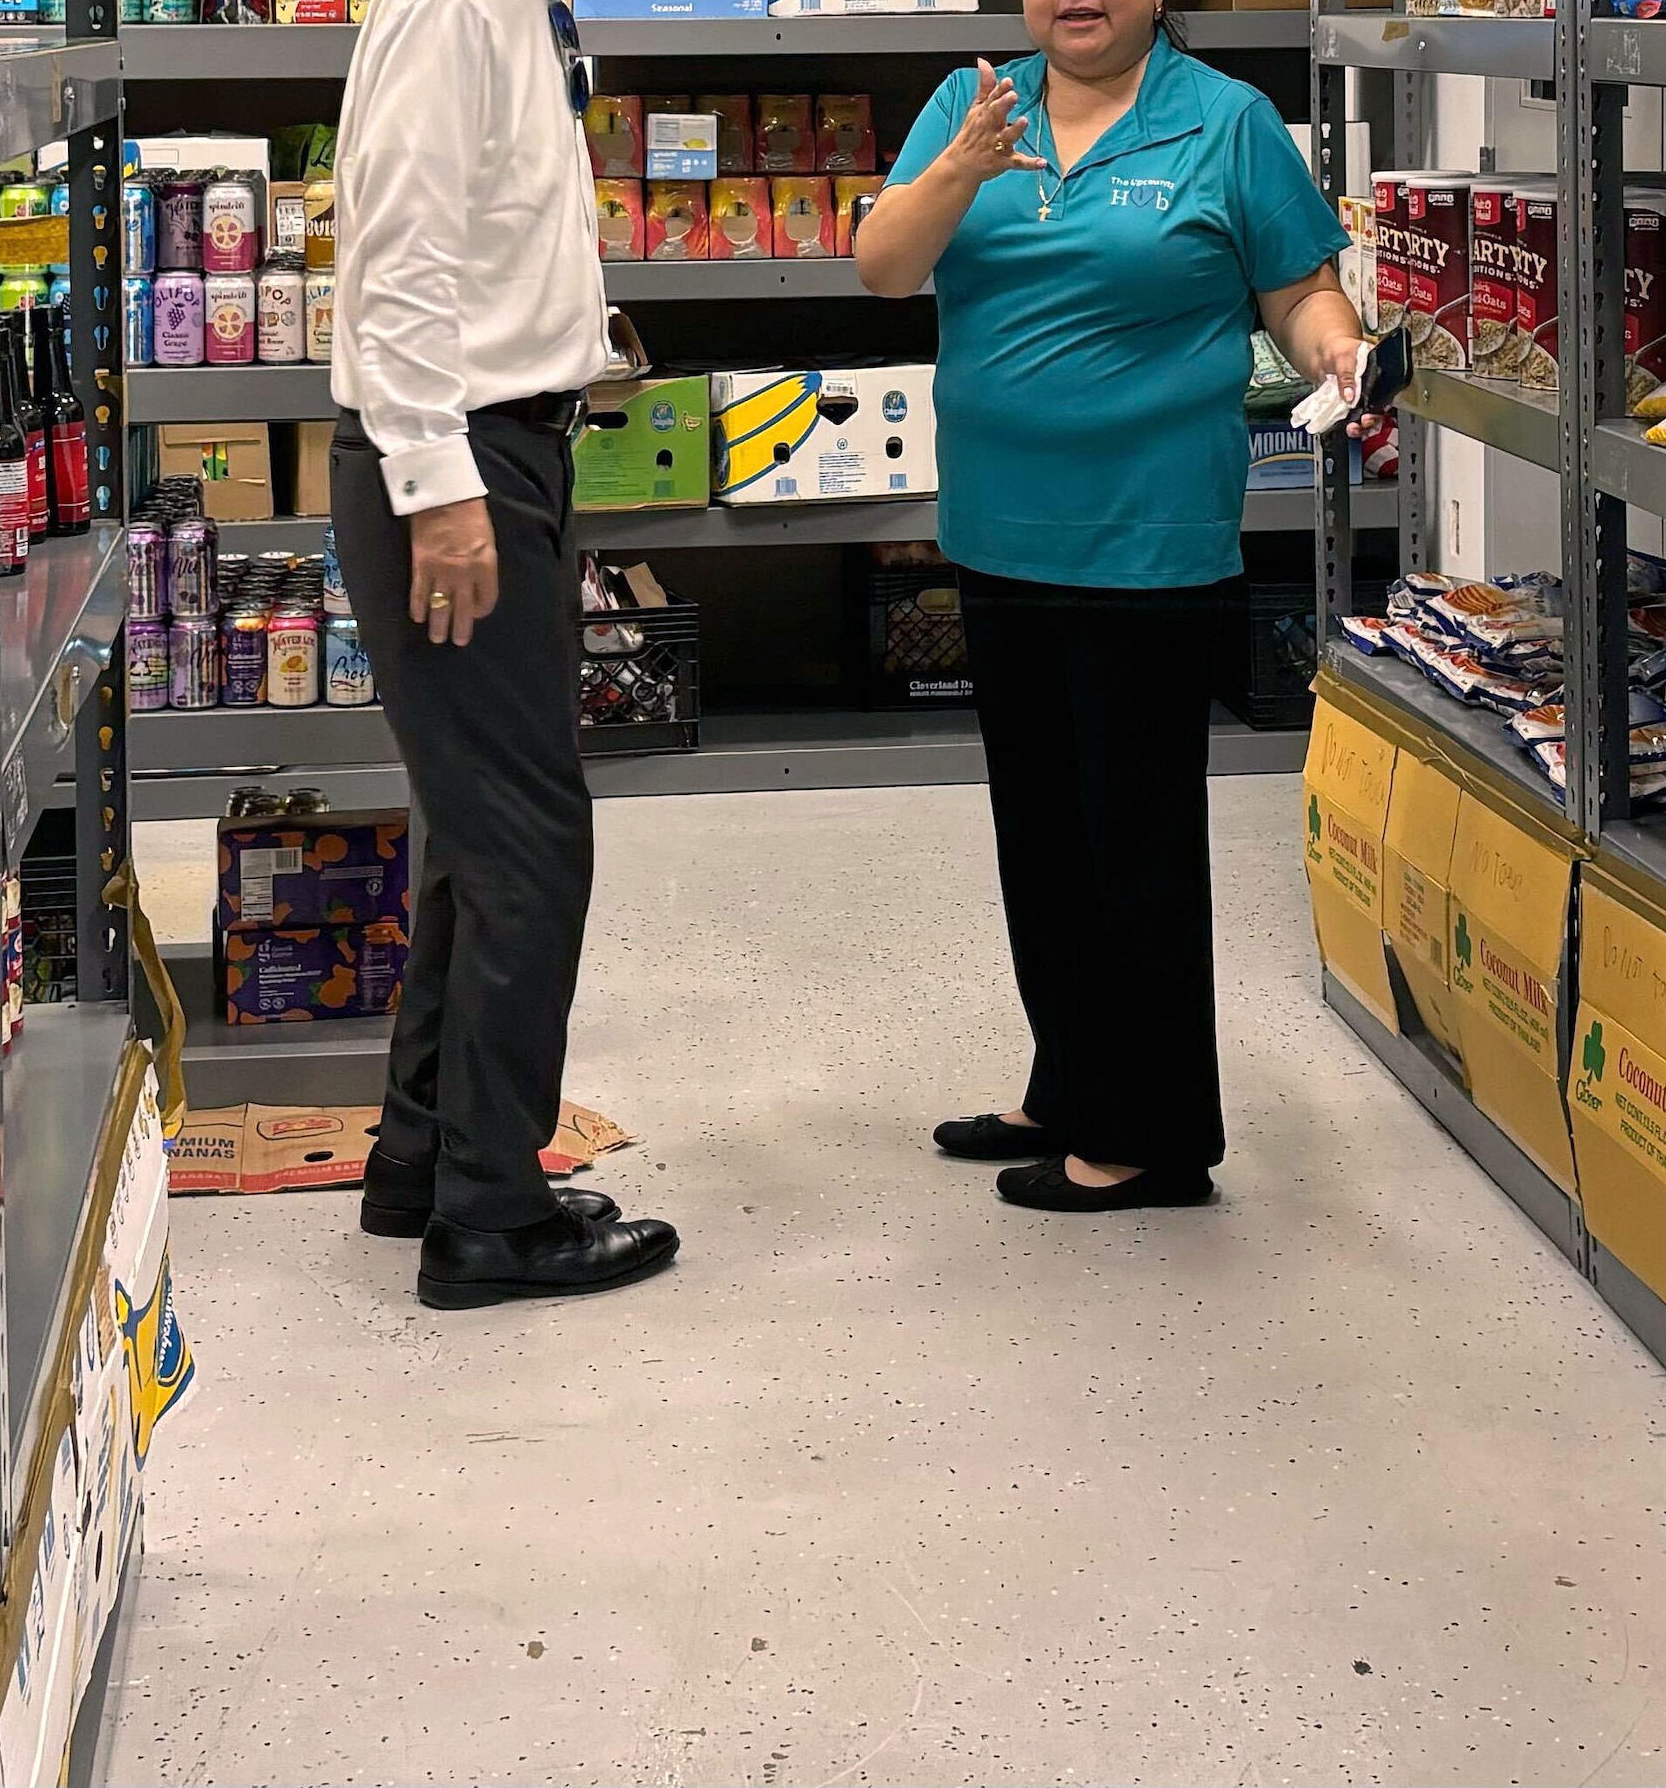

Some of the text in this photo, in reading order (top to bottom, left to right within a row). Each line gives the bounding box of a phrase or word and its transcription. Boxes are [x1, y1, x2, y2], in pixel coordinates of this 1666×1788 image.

[651, 3, 693, 12] Seasonal
[1111, 176, 1129, 186] The
[155, 286, 201, 309] OLIPOP
[1327, 813, 1359, 858] Coconut
[1360, 836, 1379, 876] Milk
[1480, 938, 1521, 996] Coconut
[175, 1137, 235, 1149] MIUM
